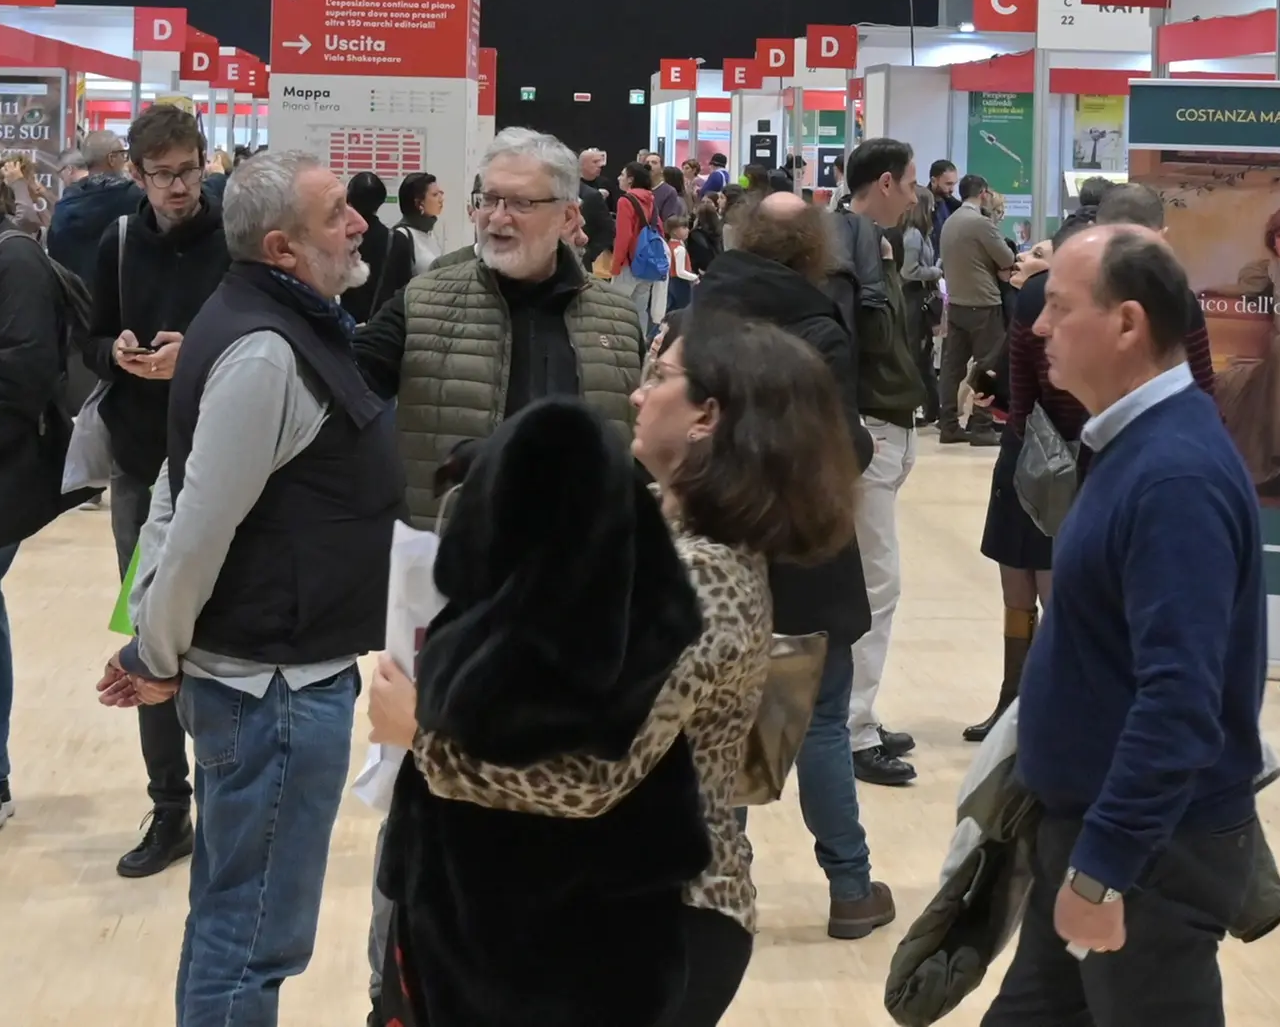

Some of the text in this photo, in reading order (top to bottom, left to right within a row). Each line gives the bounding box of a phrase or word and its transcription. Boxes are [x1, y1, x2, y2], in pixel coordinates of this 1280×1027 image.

[382, 1, 419, 9] continua
[431, 2, 455, 11] piano
[325, 10, 366, 19] superiore
[368, 10, 388, 18] dove
[412, 11, 447, 20] presenti
[1061, 15, 1074, 25] 22
[153, 19, 172, 41] D
[325, 19, 345, 27] oltre
[347, 19, 361, 27] 150
[363, 20, 393, 28] marchi
[325, 34, 386, 52] Uscita
[821, 36, 839, 58] D
[193, 52, 210, 71] D
[324, 54, 402, 64] Viale Shakespeare
[770, 48, 786, 68] D
[227, 64, 239, 80] E
[671, 67, 681, 83] E
[735, 67, 746, 84] E
[283, 86, 330, 101] Mappa
[283, 102, 341, 112] Piano Terra
[1176, 108, 1256, 123] COSTANZA
[19, 125, 50, 140] SUI
